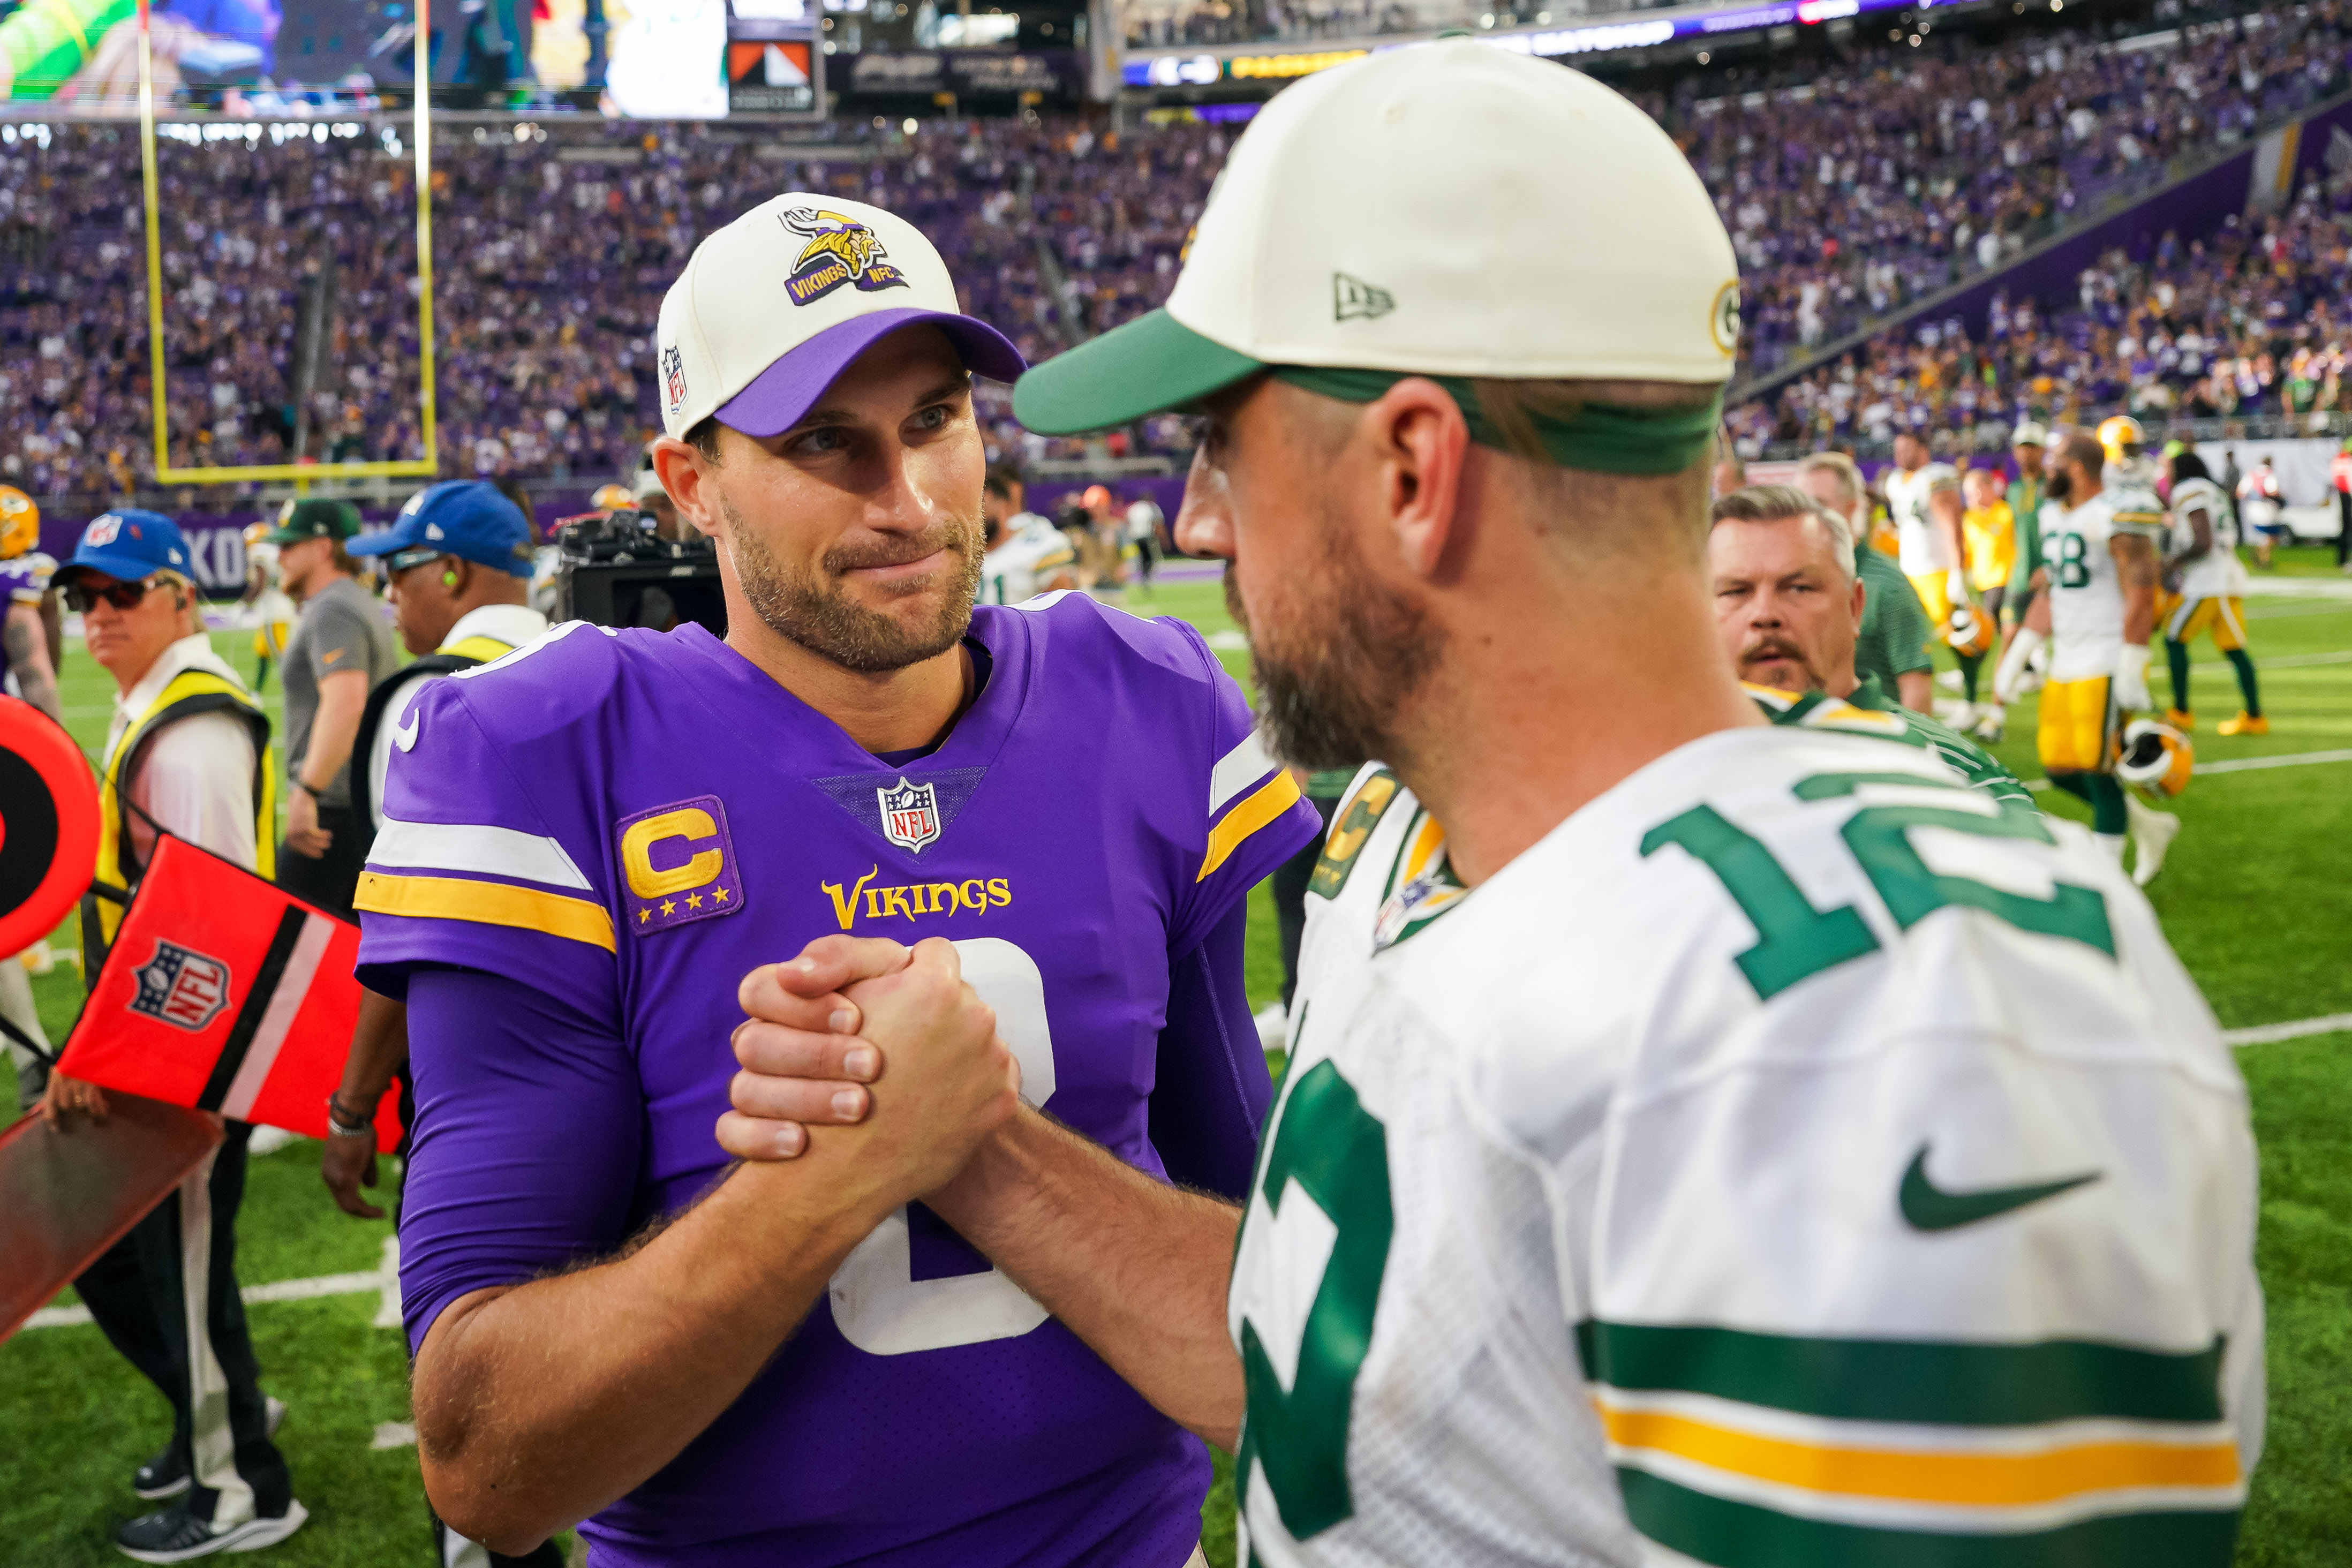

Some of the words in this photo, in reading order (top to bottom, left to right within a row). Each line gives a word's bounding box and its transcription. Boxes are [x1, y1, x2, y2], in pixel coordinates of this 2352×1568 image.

[791, 263, 847, 299] VIKINGS
[868, 267, 895, 283] NFC
[668, 372, 684, 405] NFL
[892, 809, 933, 839] NFL
[621, 807, 723, 900] C
[1640, 773, 2118, 1001] 12
[167, 967, 220, 1022] NFL
